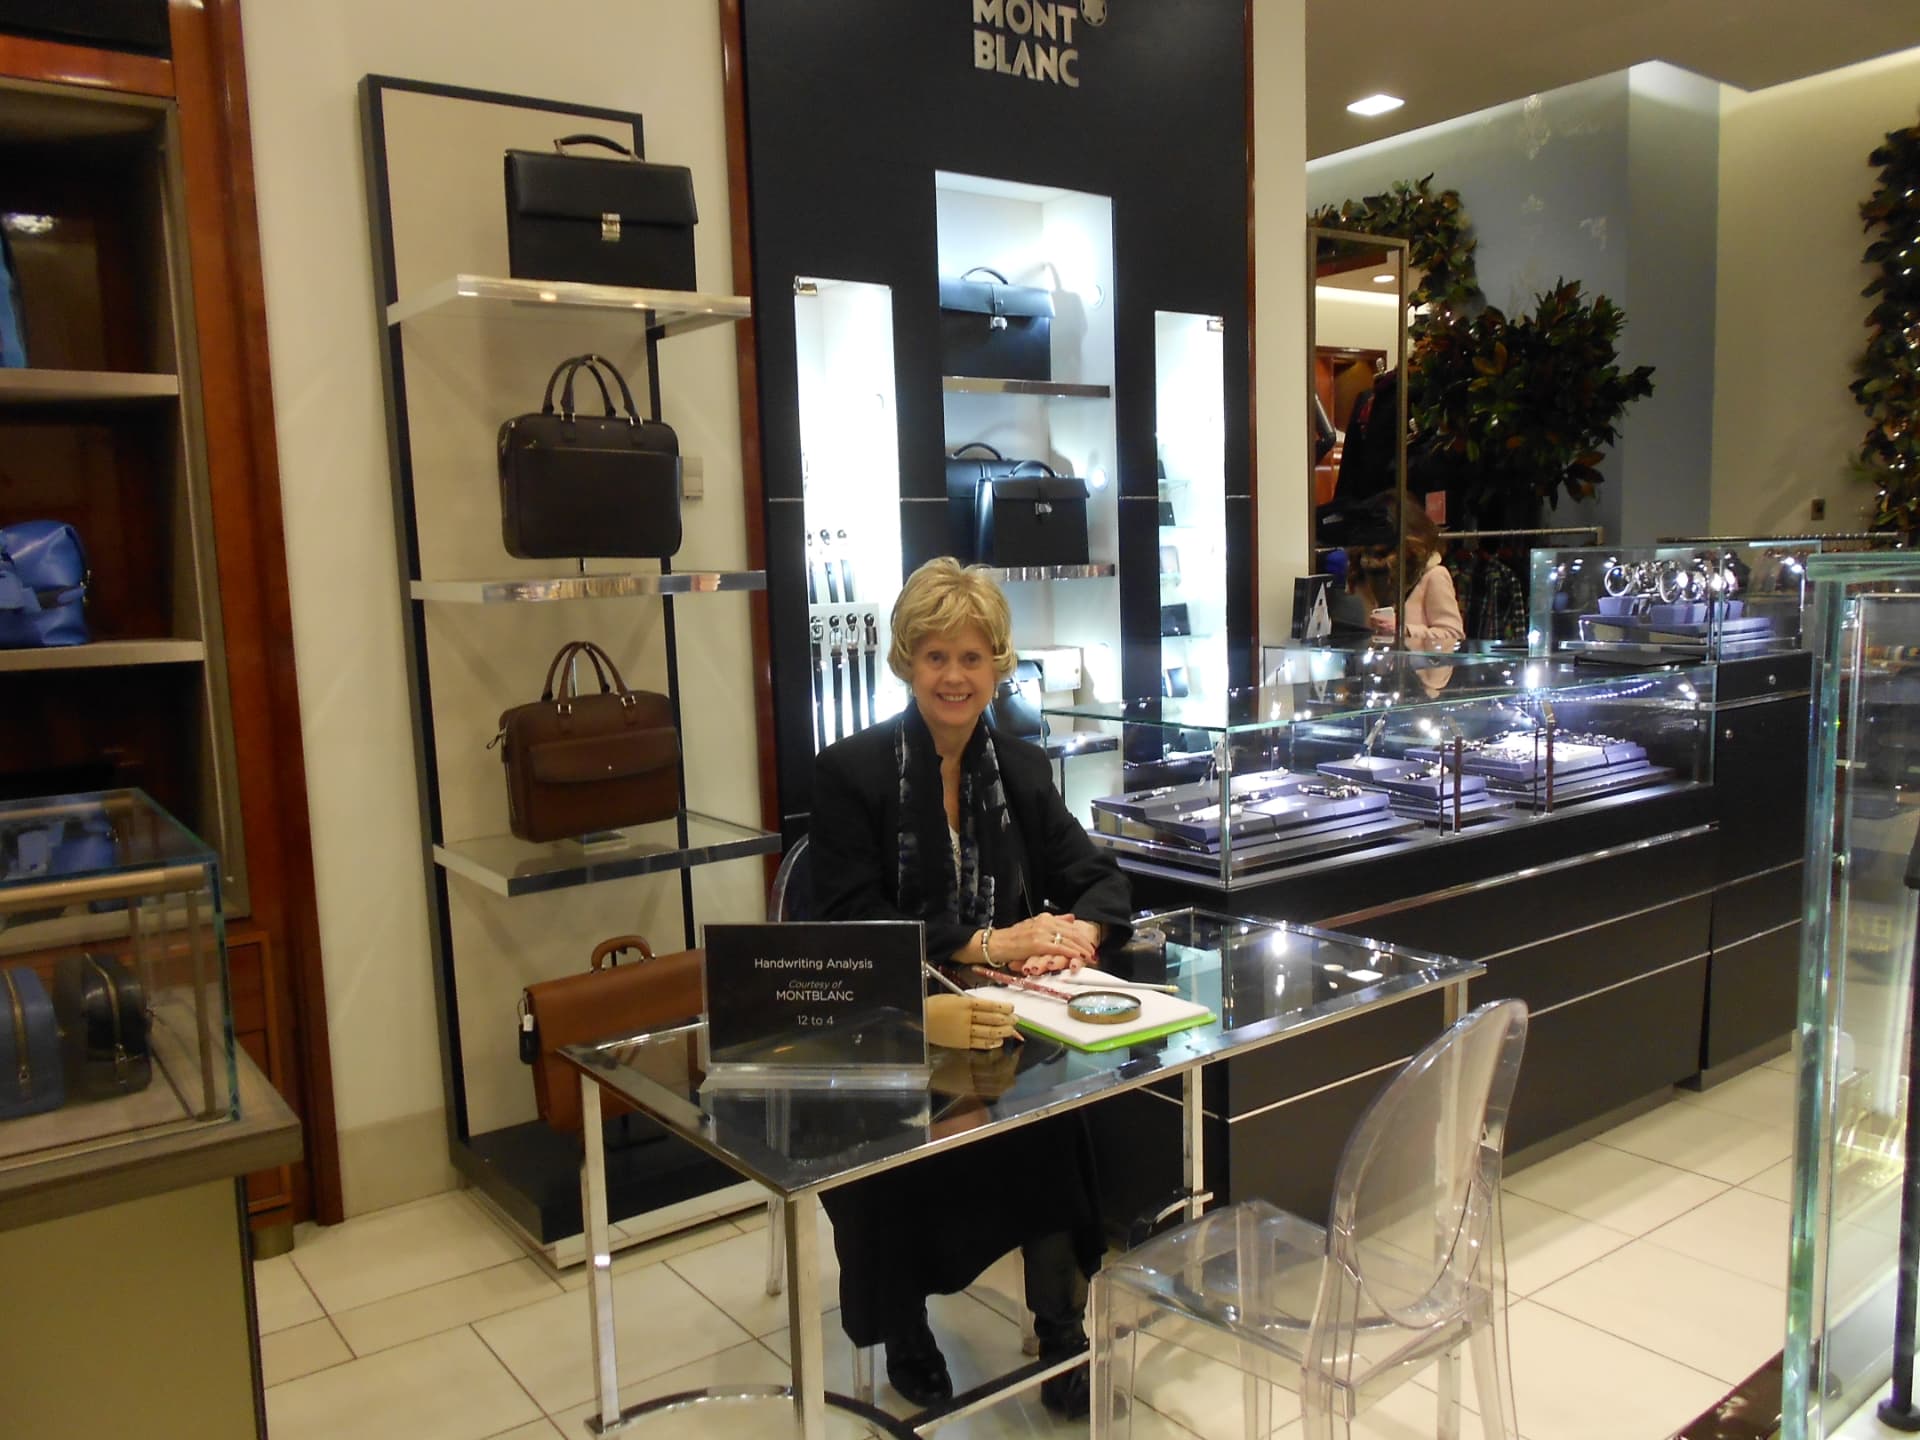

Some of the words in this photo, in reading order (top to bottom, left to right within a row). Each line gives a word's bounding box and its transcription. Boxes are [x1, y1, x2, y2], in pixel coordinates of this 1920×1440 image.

[973, 0, 1078, 44] MONT
[974, 29, 1080, 88] BLANC
[754, 958, 823, 970] Handwriting
[826, 958, 873, 970] Analysis
[788, 979, 831, 990] Courtesy
[831, 979, 843, 989] of
[776, 990, 854, 1001] MONTBLANC
[797, 1015, 808, 1025] 12
[811, 1015, 823, 1025] to
[826, 1015, 834, 1025] 4
